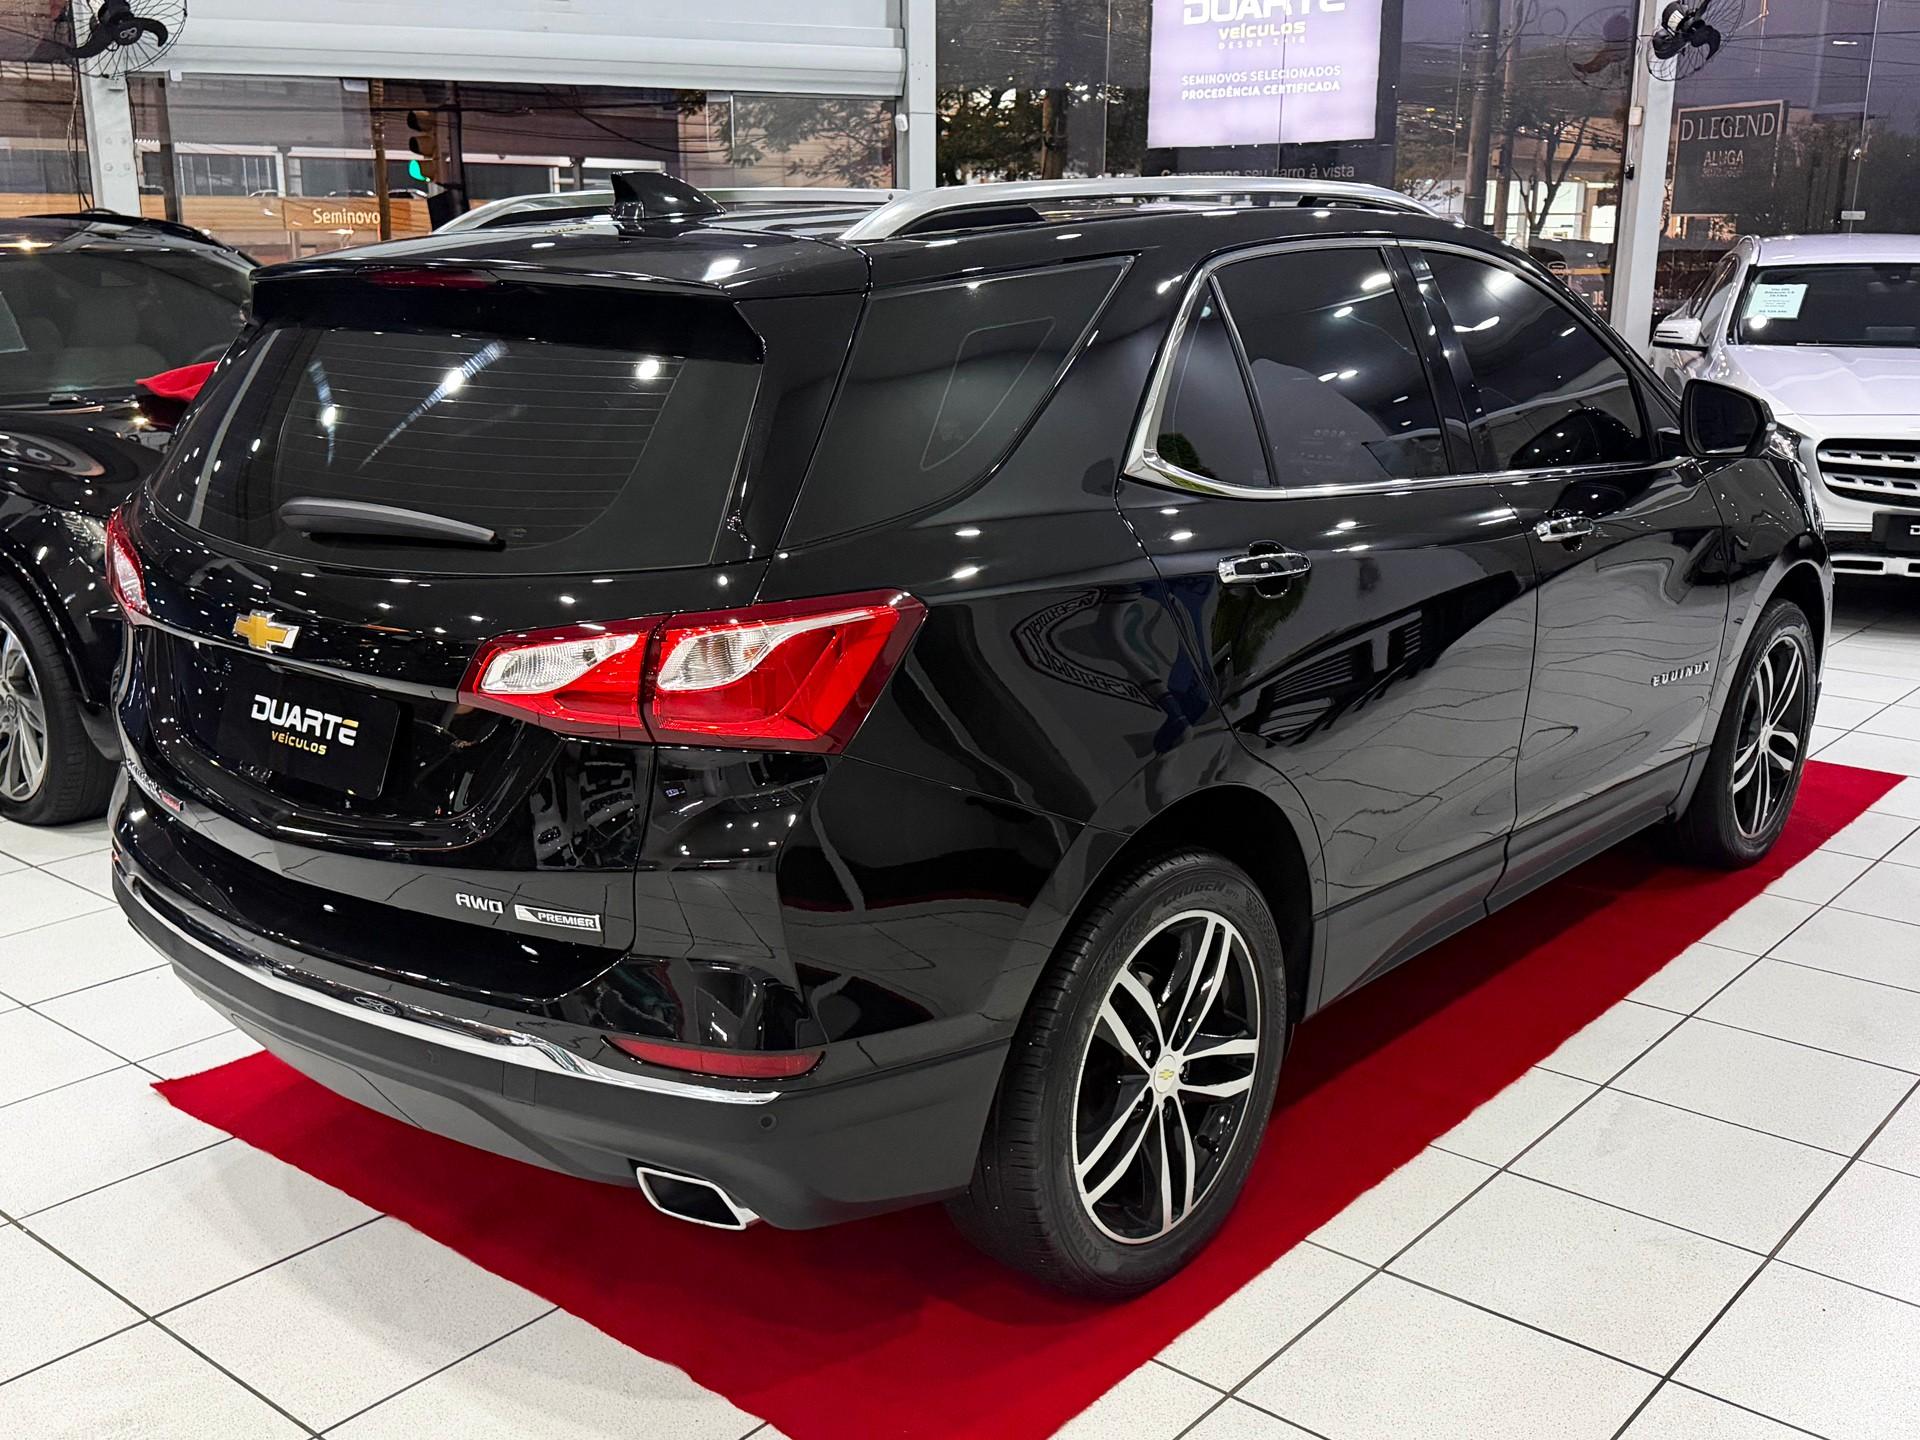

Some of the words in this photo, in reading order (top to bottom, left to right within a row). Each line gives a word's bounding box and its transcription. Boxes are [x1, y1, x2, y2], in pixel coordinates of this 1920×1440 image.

[1182, 71, 1247, 86] SEMINOVOS
[1250, 65, 1341, 82] SELECIONADOS
[1182, 84, 1260, 101] PROCEDÊNCIA
[1263, 80, 1341, 96] CERTIFICADA
[1681, 119, 1694, 141] D
[1697, 112, 1775, 140] LEGEND
[1309, 163, 1319, 178] à
[1322, 163, 1355, 178] vista
[251, 694, 359, 746] DUARTE
[271, 730, 328, 755] VEÍCULOS
[455, 892, 504, 914] AWD
[537, 912, 595, 928] PREMIER
